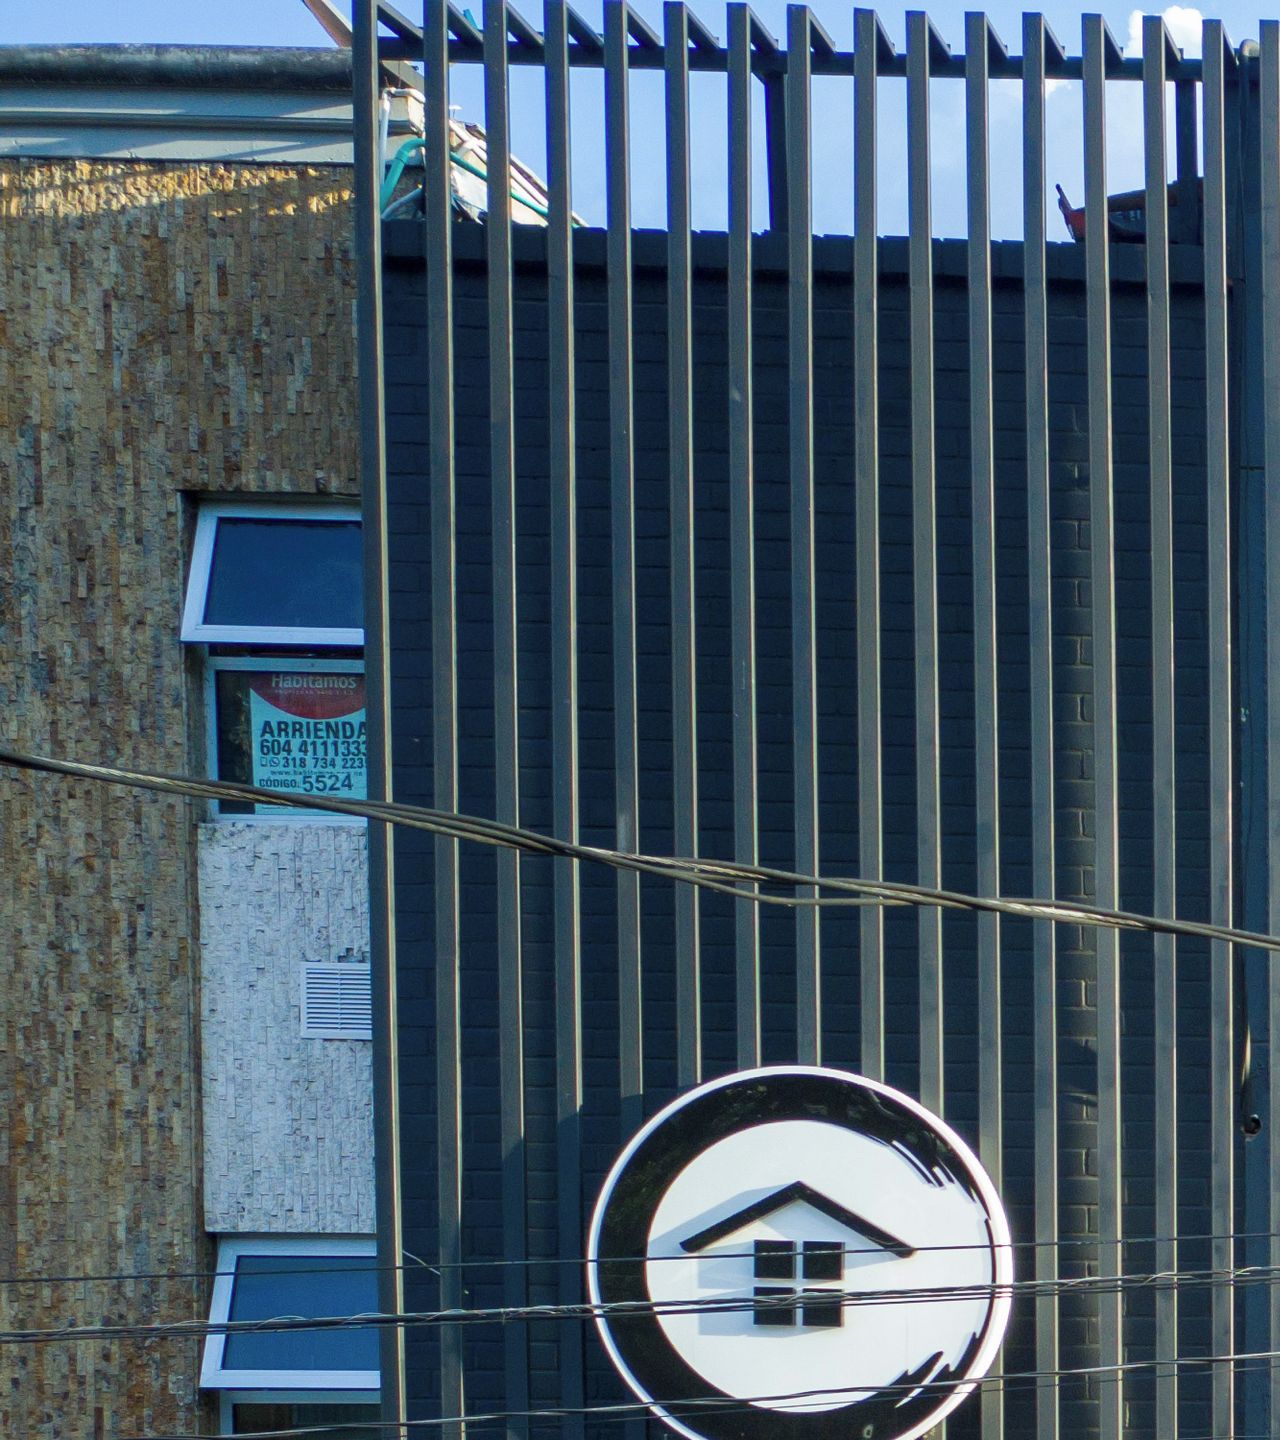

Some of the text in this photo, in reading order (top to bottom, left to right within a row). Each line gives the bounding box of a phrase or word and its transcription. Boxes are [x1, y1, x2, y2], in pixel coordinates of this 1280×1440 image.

[271, 673, 357, 689] Habitamos
[260, 720, 367, 739] ARRIENDA
[260, 739, 292, 756] 604
[282, 757, 307, 769] 318
[312, 757, 337, 769] 734
[302, 774, 354, 792] 5524
